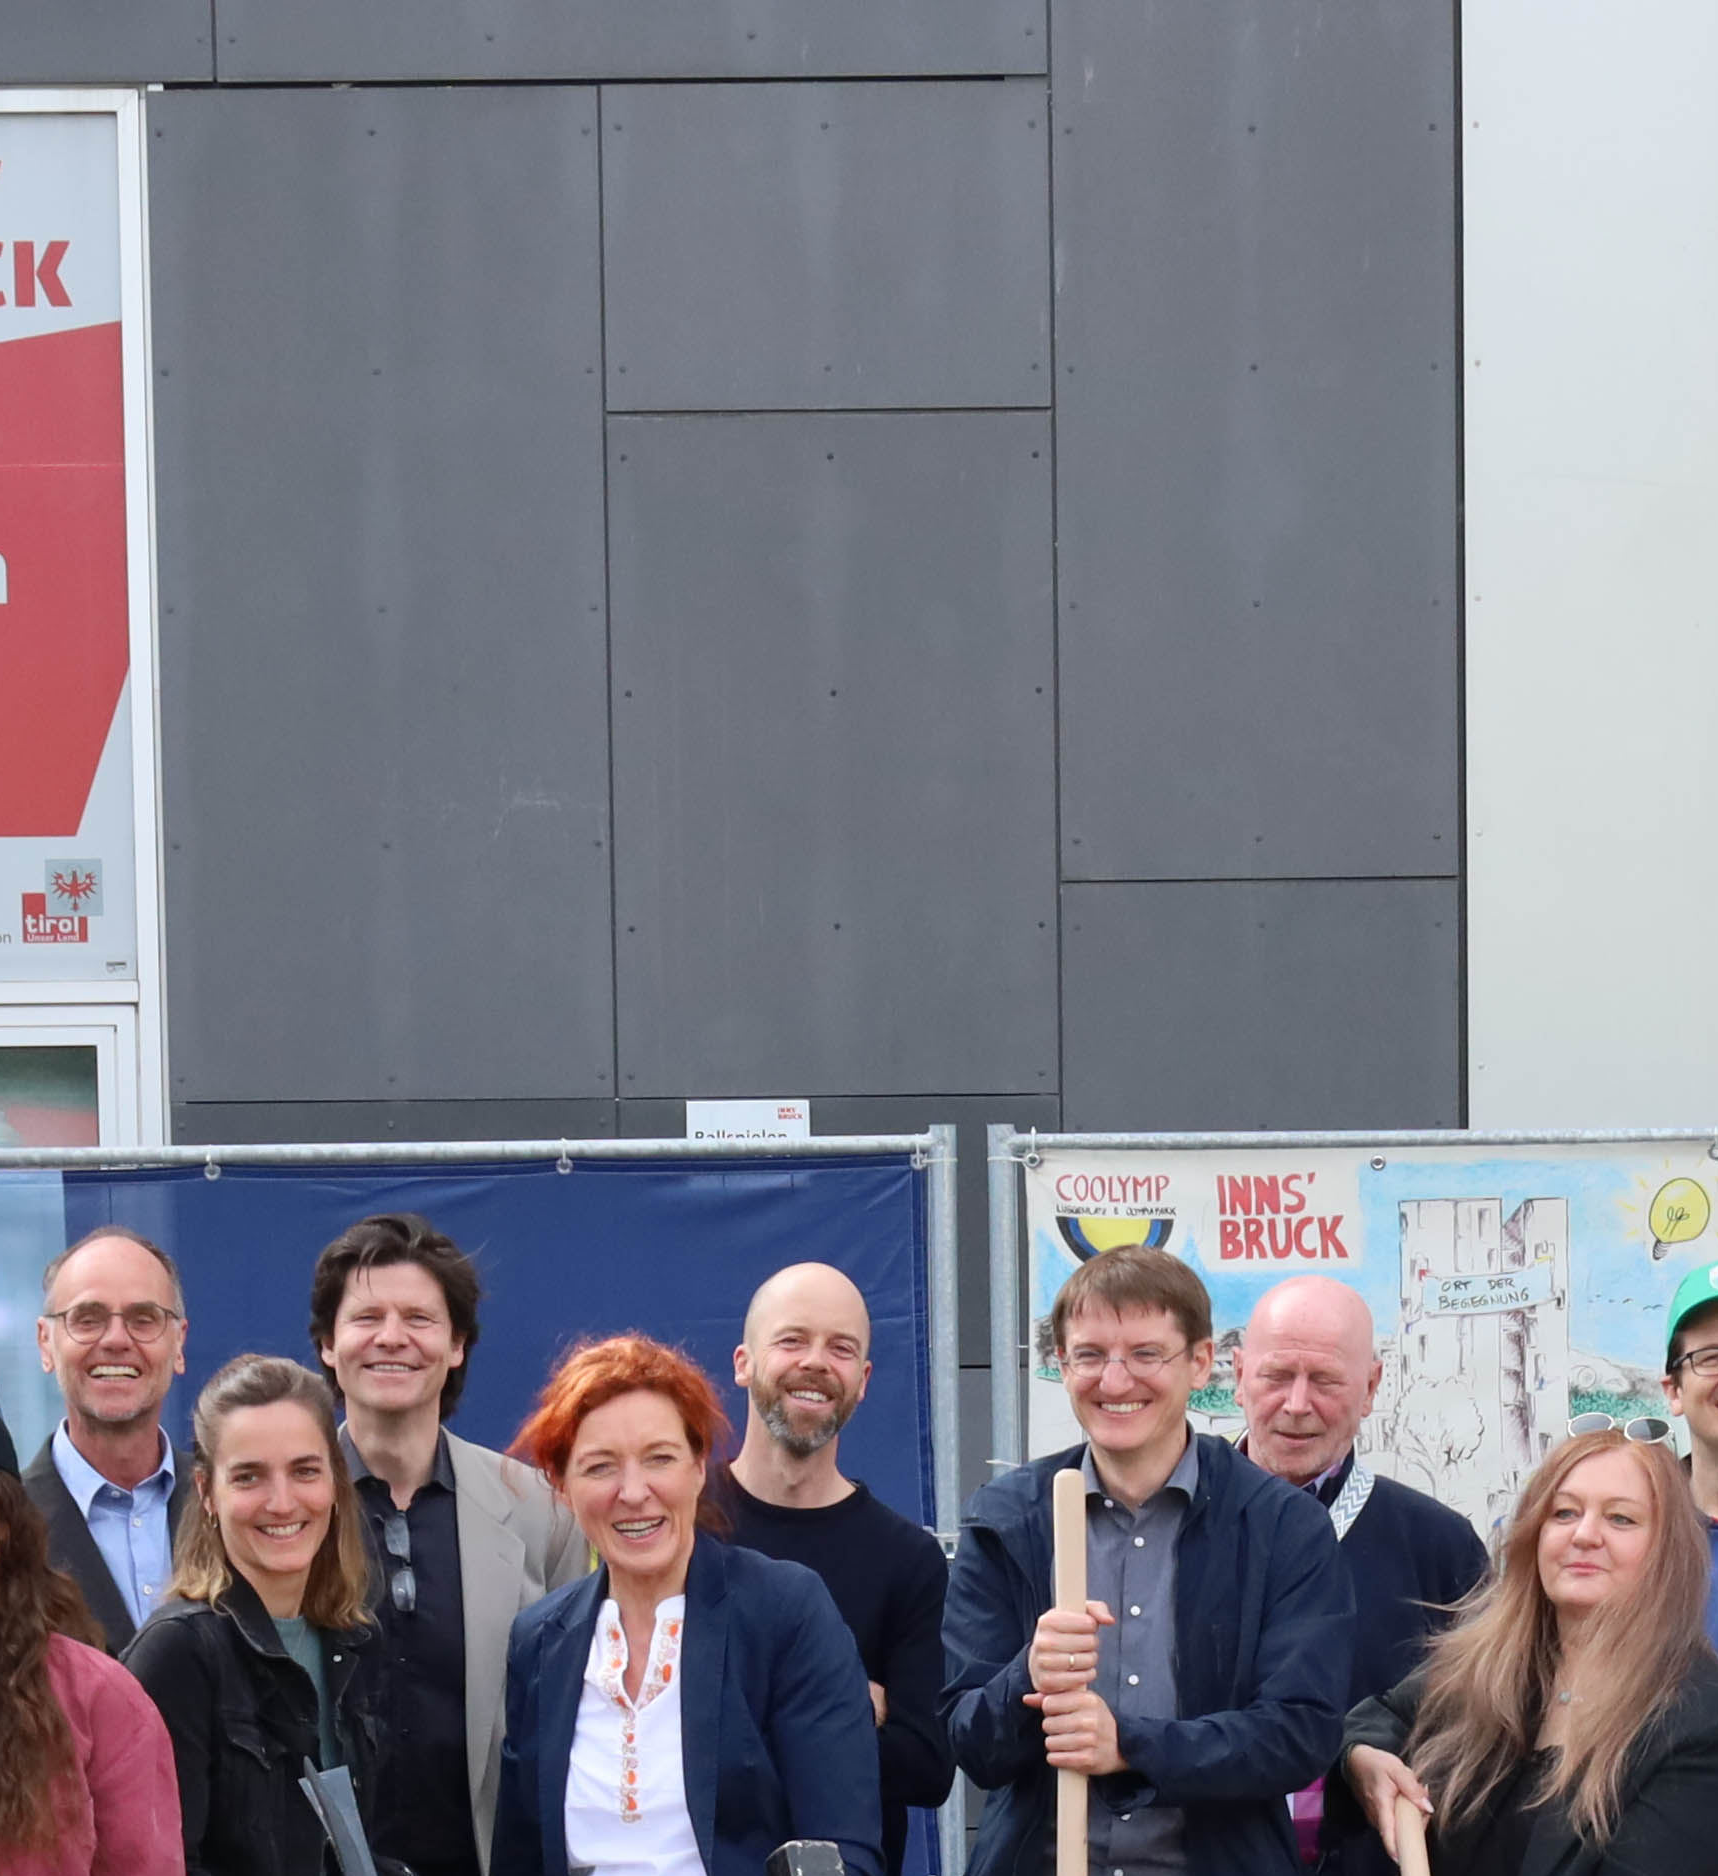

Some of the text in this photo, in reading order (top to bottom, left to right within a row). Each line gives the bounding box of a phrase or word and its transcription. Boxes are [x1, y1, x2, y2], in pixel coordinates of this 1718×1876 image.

[25, 913, 79, 934] tirol
[1056, 1171, 1316, 1216] COOLYMP INNS'
[1219, 1215, 1349, 1260] BRUCK
[1441, 1277, 1516, 1293] ORT DER
[1438, 1287, 1530, 1310] BEGEGNUNG
